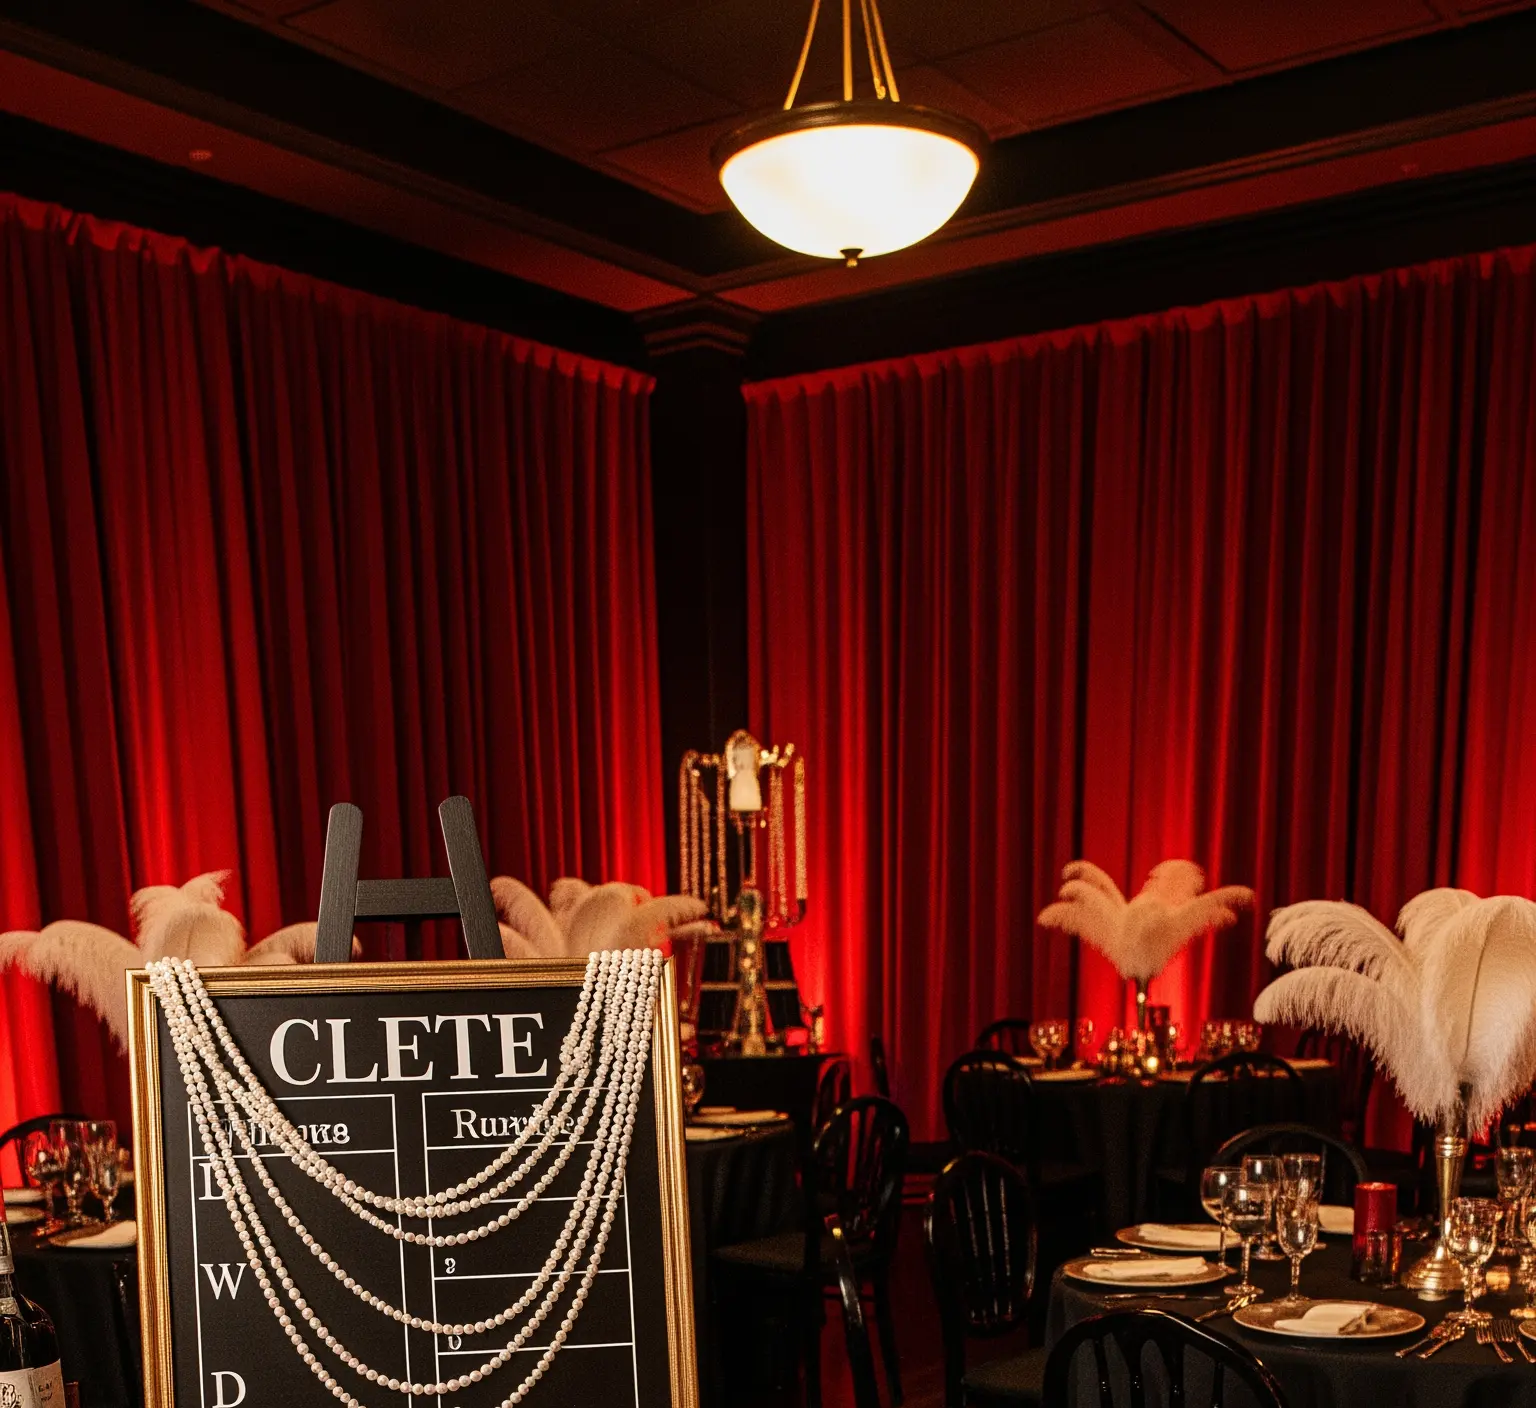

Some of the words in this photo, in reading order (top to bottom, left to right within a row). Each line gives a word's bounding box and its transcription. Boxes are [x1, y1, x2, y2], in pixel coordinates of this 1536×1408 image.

[269, 1013, 548, 1086] CLETE
[199, 1262, 248, 1301] W
[210, 1370, 247, 1408] D
